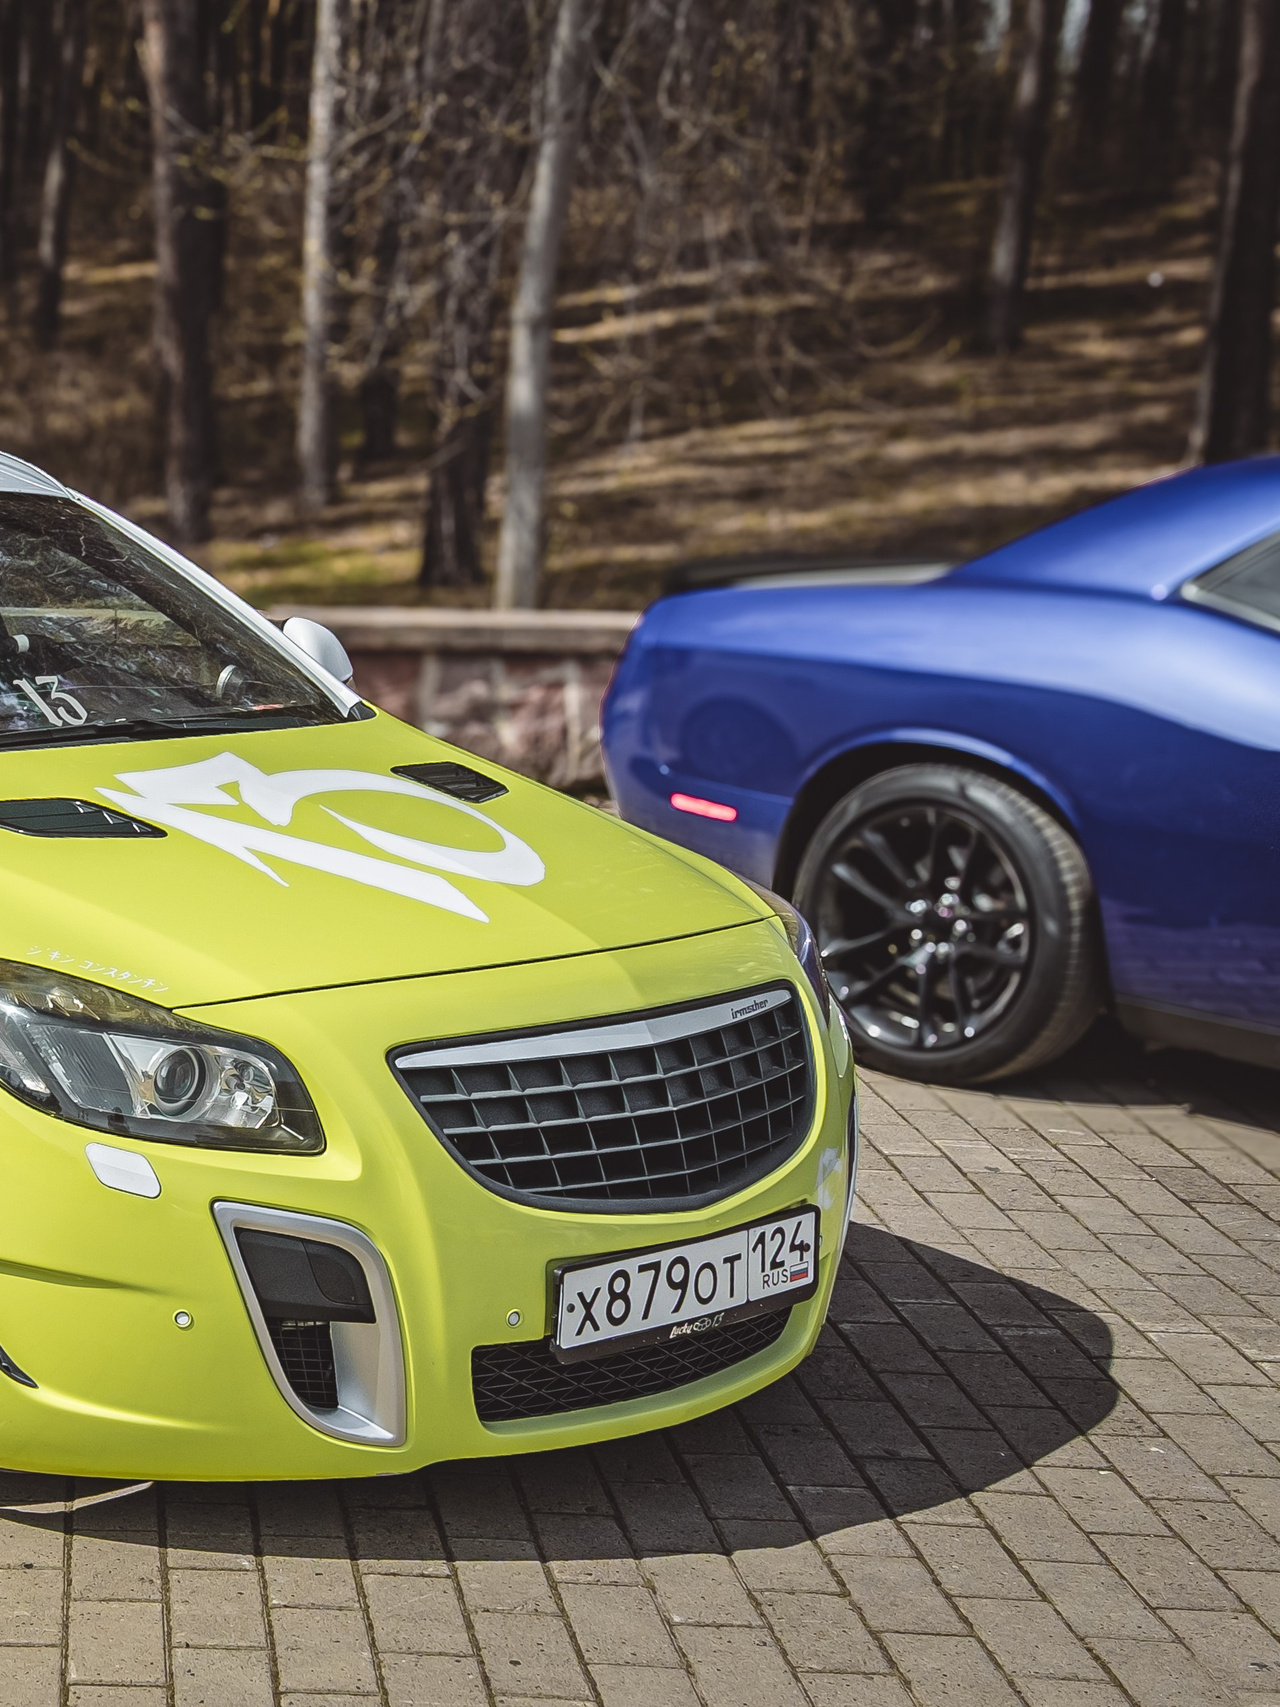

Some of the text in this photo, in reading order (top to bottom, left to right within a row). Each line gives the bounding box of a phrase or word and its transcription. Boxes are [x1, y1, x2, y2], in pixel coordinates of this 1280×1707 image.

[13, 675, 88, 727] 13
[730, 999, 769, 1019] irmscher
[752, 1221, 810, 1273] 124
[762, 1268, 789, 1290] RUS
[669, 1322, 693, 1339] Lucky
